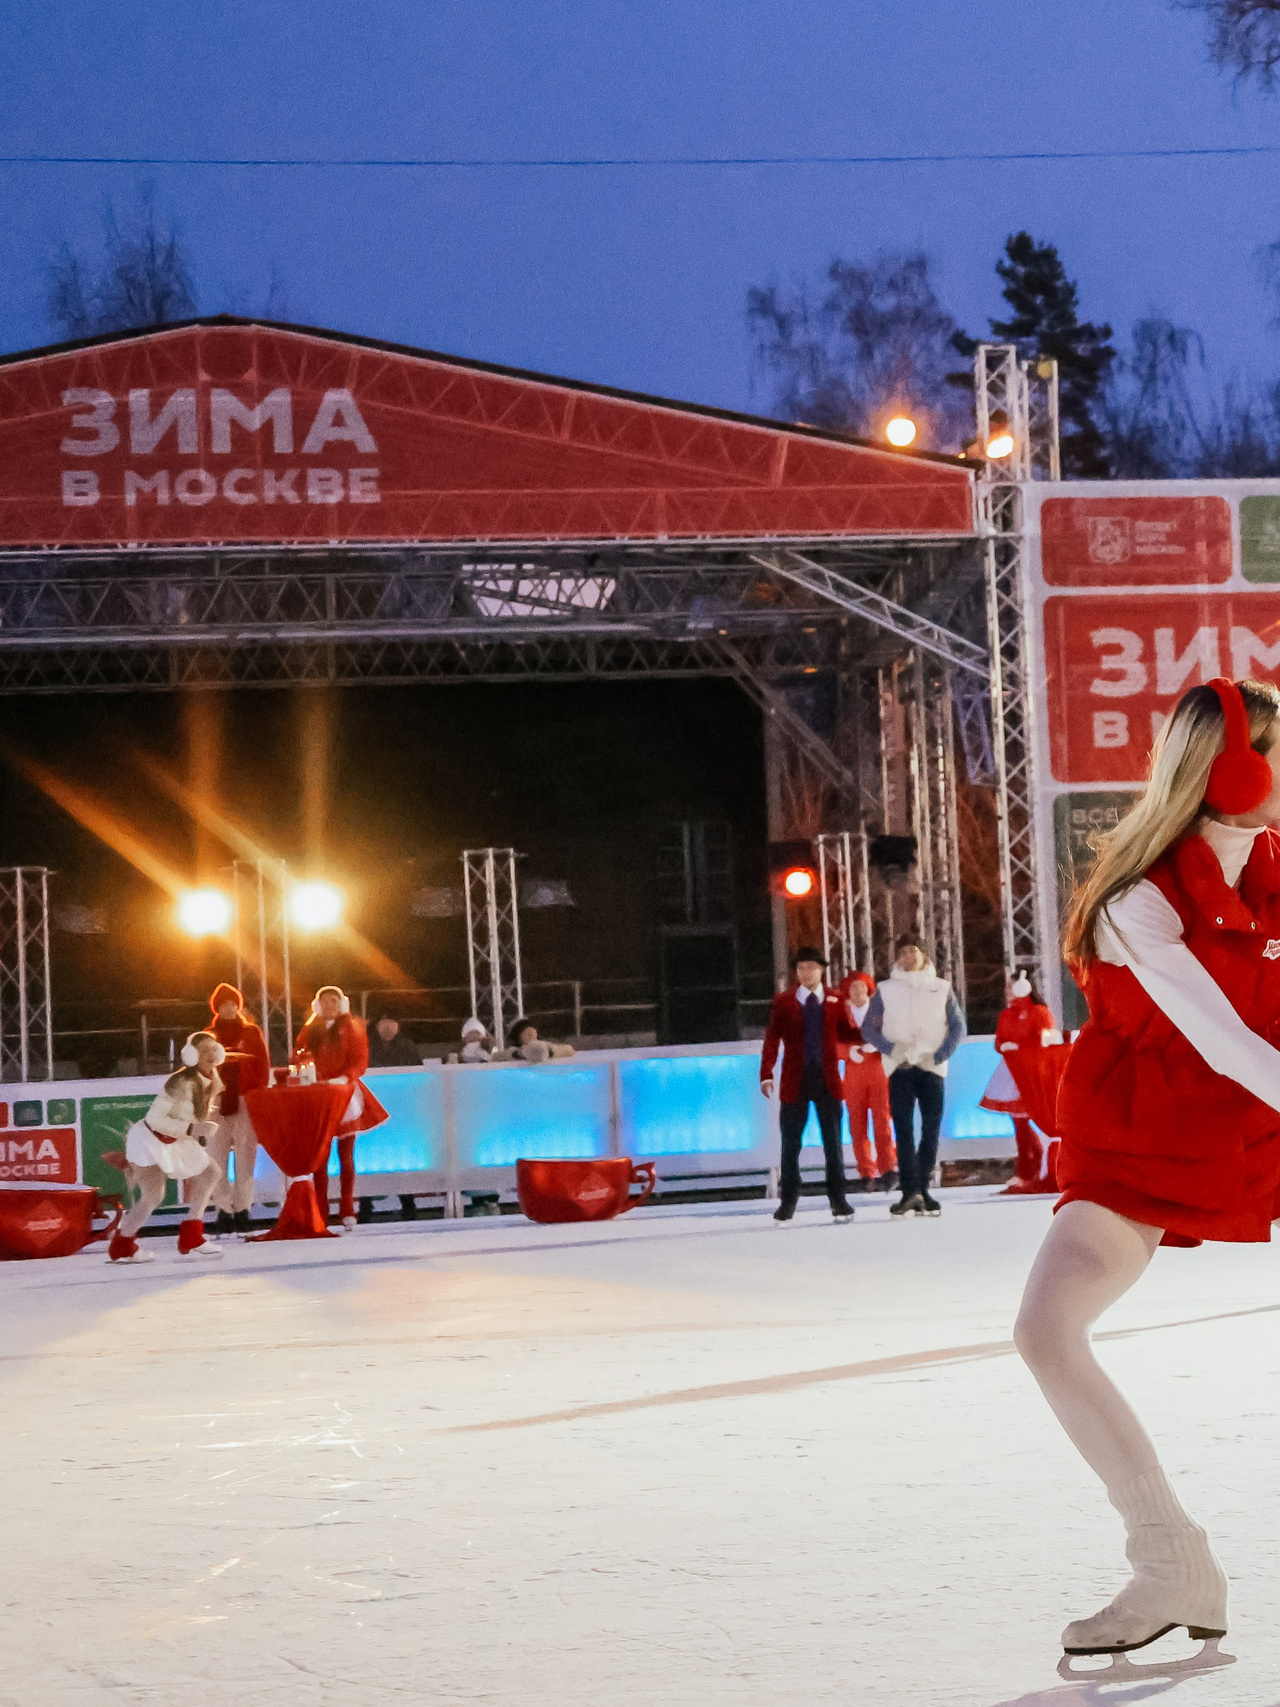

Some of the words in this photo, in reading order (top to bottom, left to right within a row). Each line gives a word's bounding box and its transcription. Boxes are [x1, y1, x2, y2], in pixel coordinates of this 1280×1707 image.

[60, 387, 379, 457] ЗИМА
[62, 470, 101, 507] В
[124, 467, 382, 506] МОСКВЕ
[1093, 710, 1130, 748] В
[0, 1140, 59, 1161] МА
